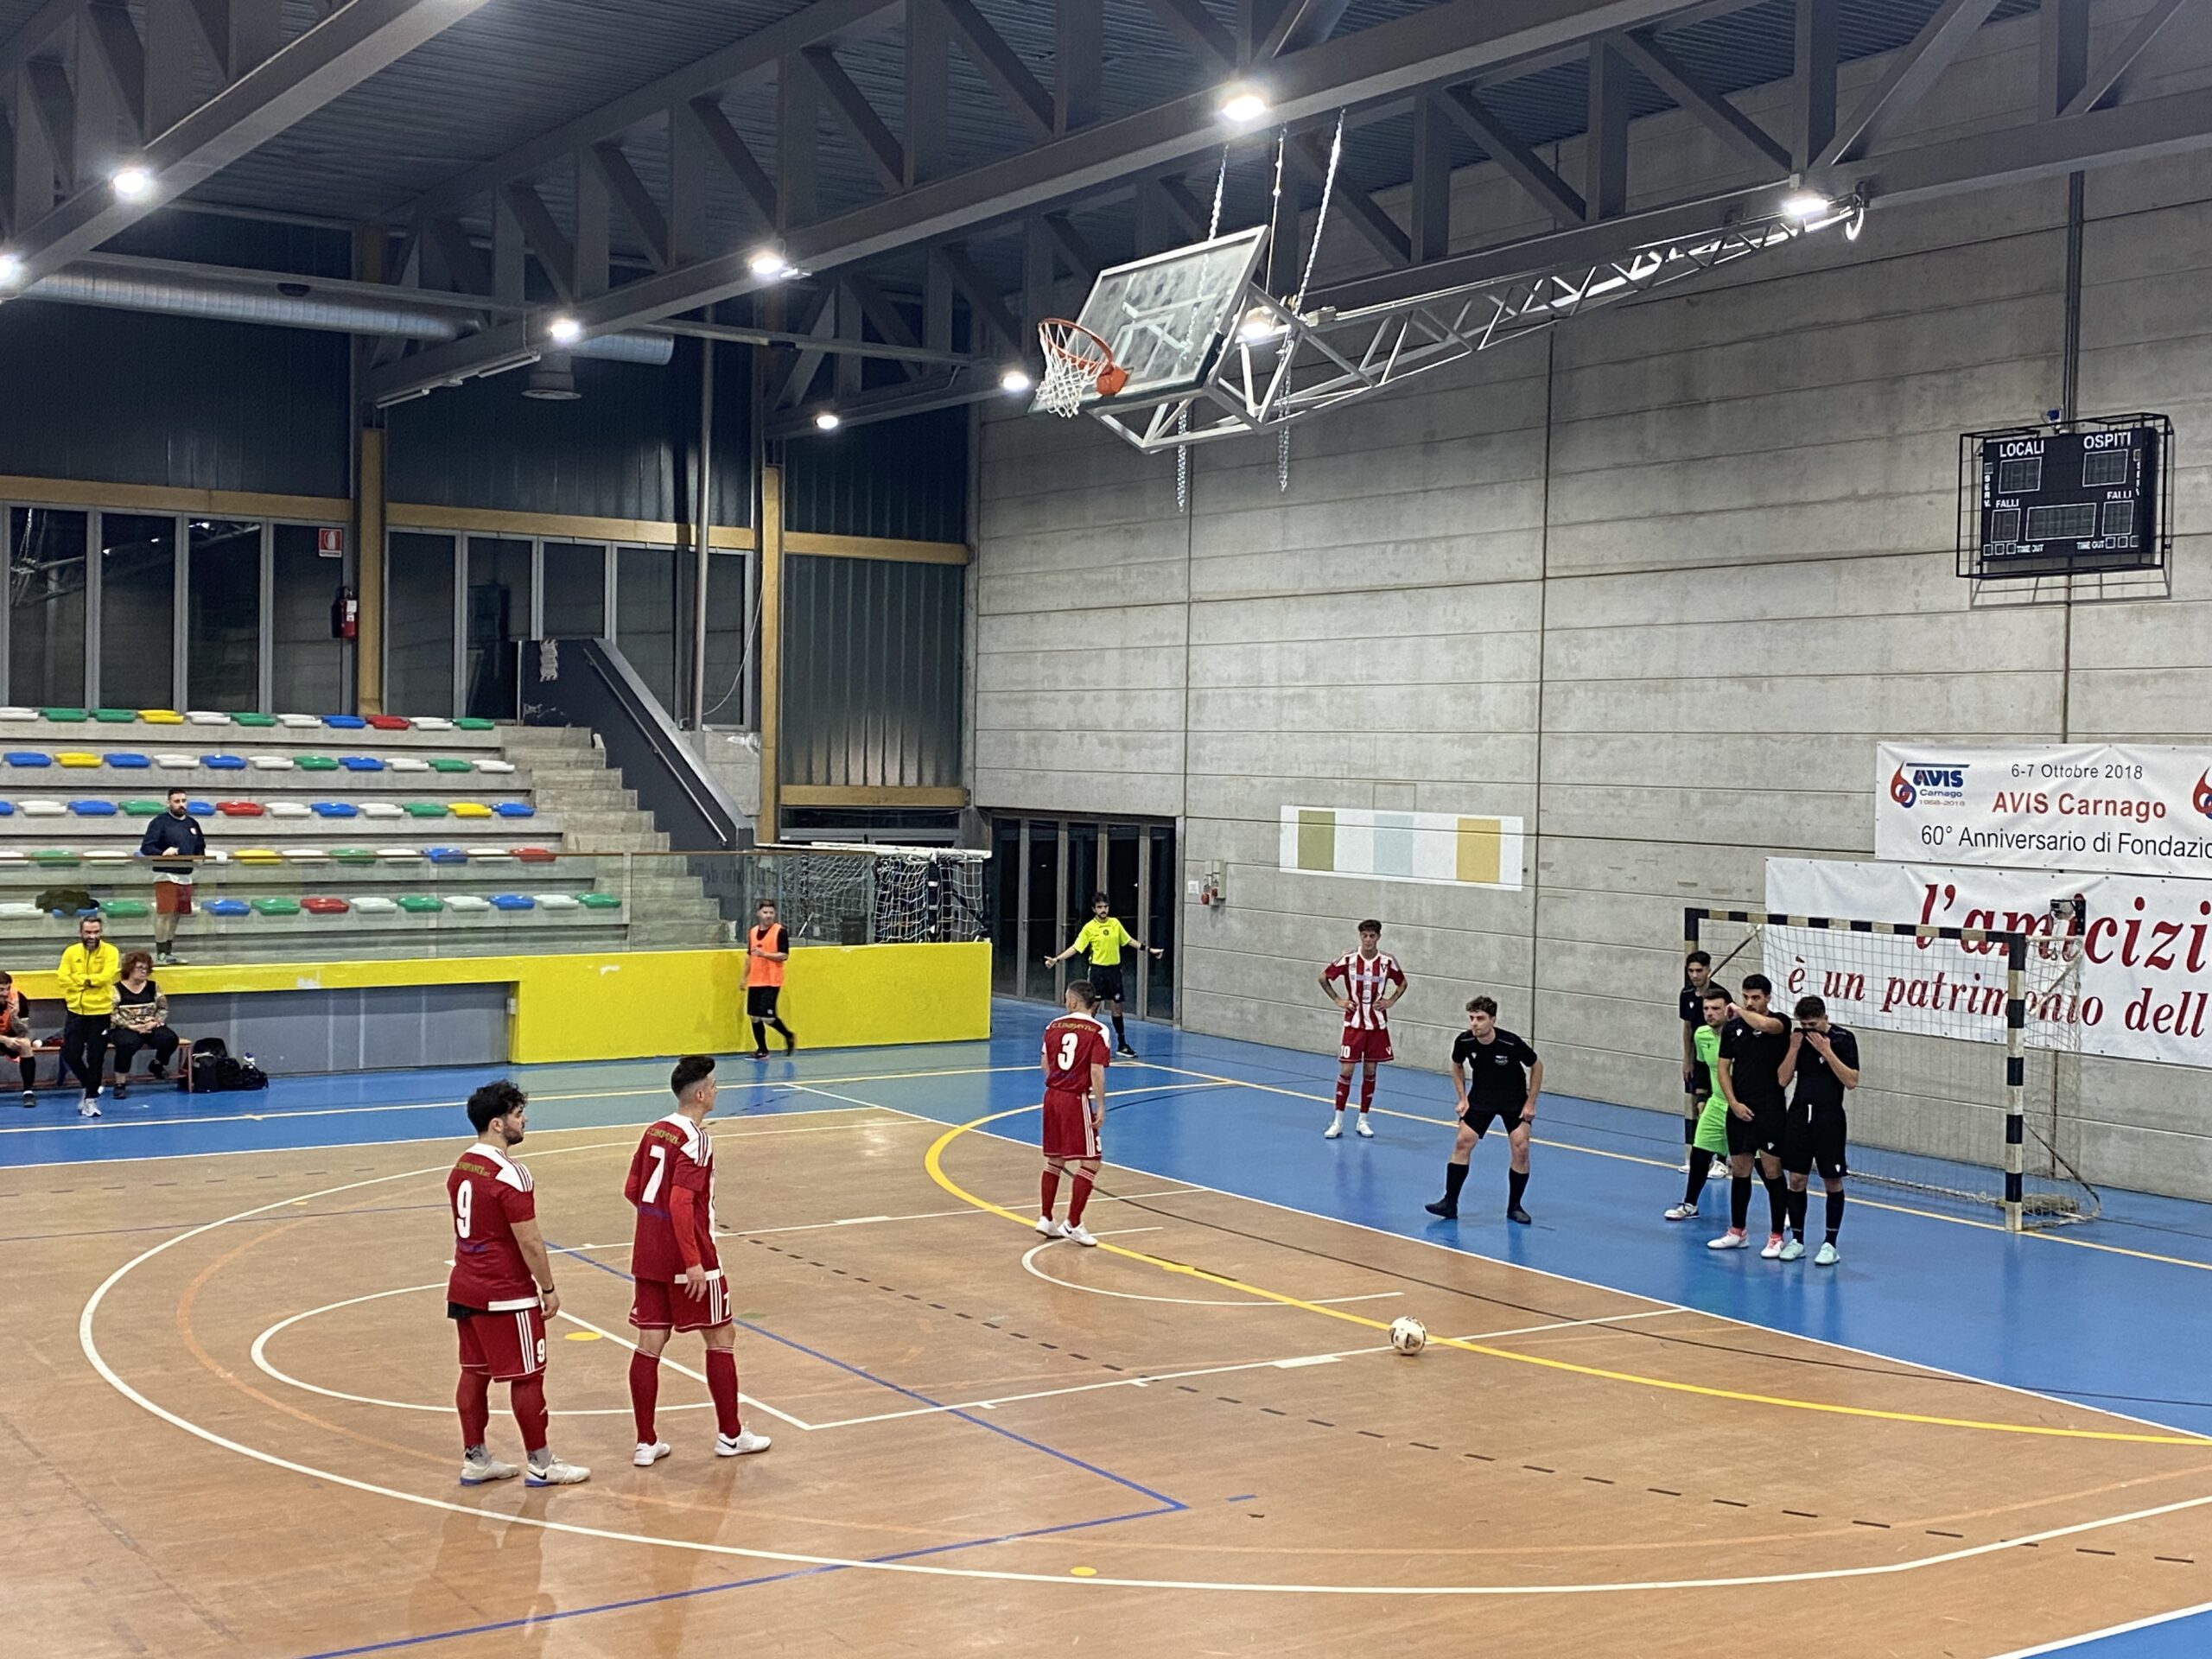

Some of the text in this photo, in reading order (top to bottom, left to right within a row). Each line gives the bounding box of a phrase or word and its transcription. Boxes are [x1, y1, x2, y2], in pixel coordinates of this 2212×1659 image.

[1999, 440, 2044, 457] LOCALI
[2083, 432, 2131, 449] OSPITI
[1996, 499, 2019, 508] FALLI
[2107, 491, 2132, 500] FALLI
[1912, 770, 1963, 788] AVIS
[2012, 764, 2143, 779] 6-7 Ottobre 2018
[1920, 789, 1963, 798] Carnago
[1992, 791, 2167, 823] AVIS Carnago
[1921, 825, 1953, 845] 60°
[1959, 827, 2086, 852] Anniversario
[2093, 832, 2111, 853] di
[1788, 956, 1806, 995] è
[1823, 970, 1866, 1002] un
[1058, 1033, 1078, 1071] 3
[1340, 1046, 1351, 1058] 10
[641, 1145, 666, 1204] 7
[456, 1179, 473, 1239] 9
[537, 1338, 545, 1363] 9
